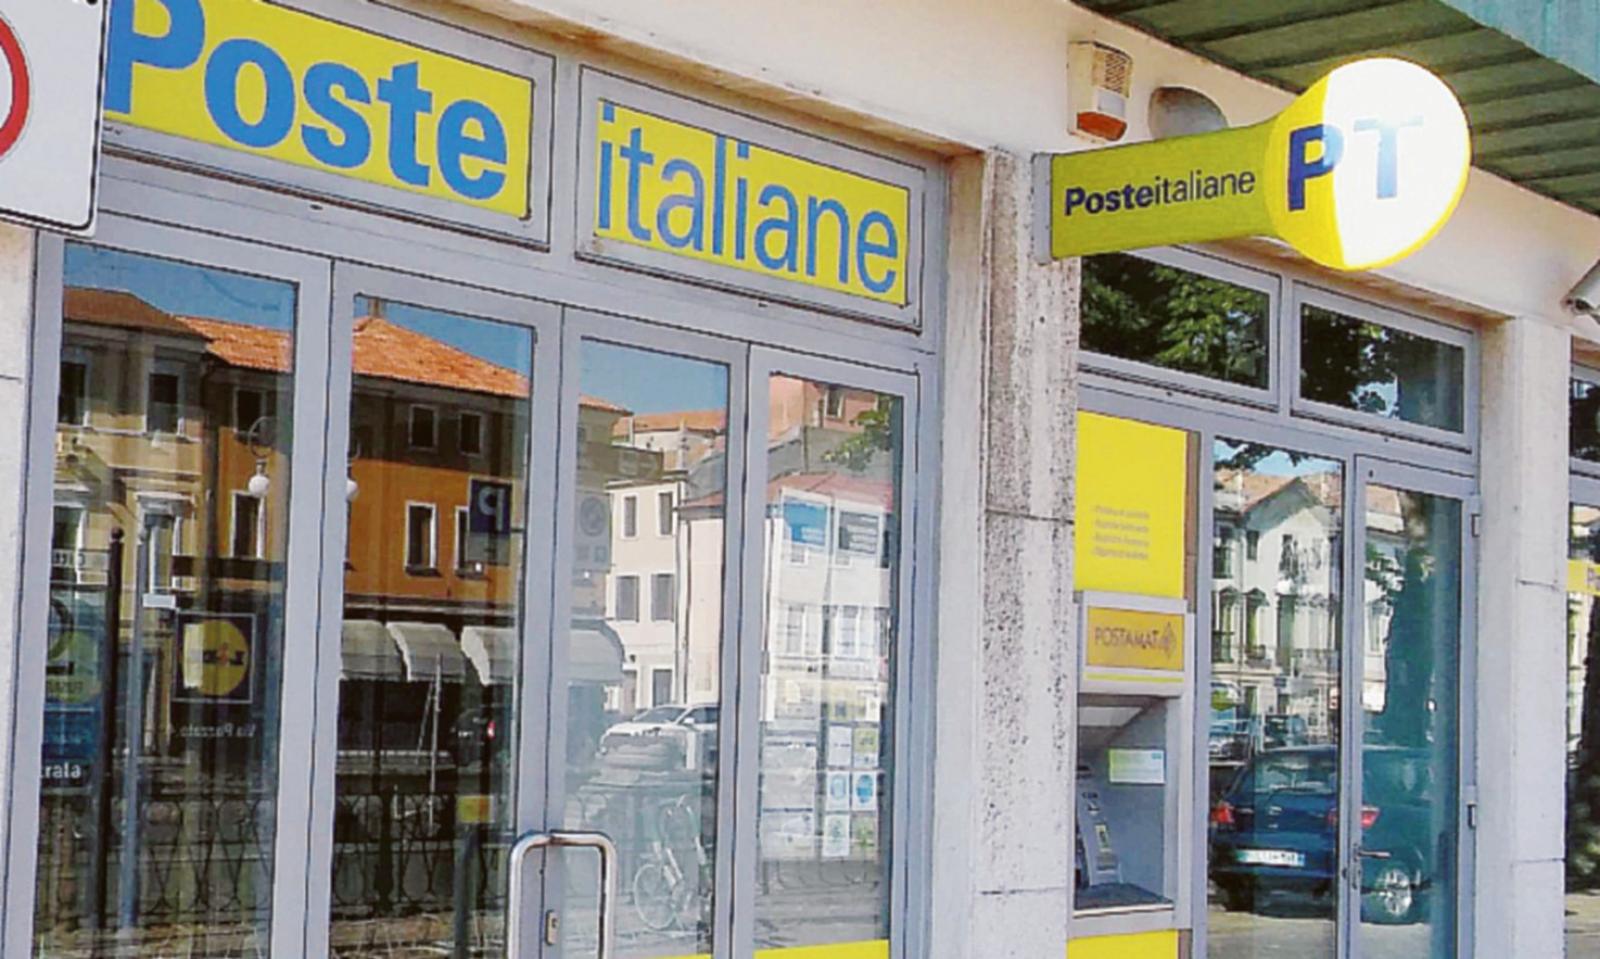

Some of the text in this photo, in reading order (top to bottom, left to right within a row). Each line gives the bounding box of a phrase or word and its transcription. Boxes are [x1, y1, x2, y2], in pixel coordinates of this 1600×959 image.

[103, 0, 899, 294] Poste italiane
[1063, 167, 1256, 217] Posteitaliane
[1286, 115, 1424, 212] PT
